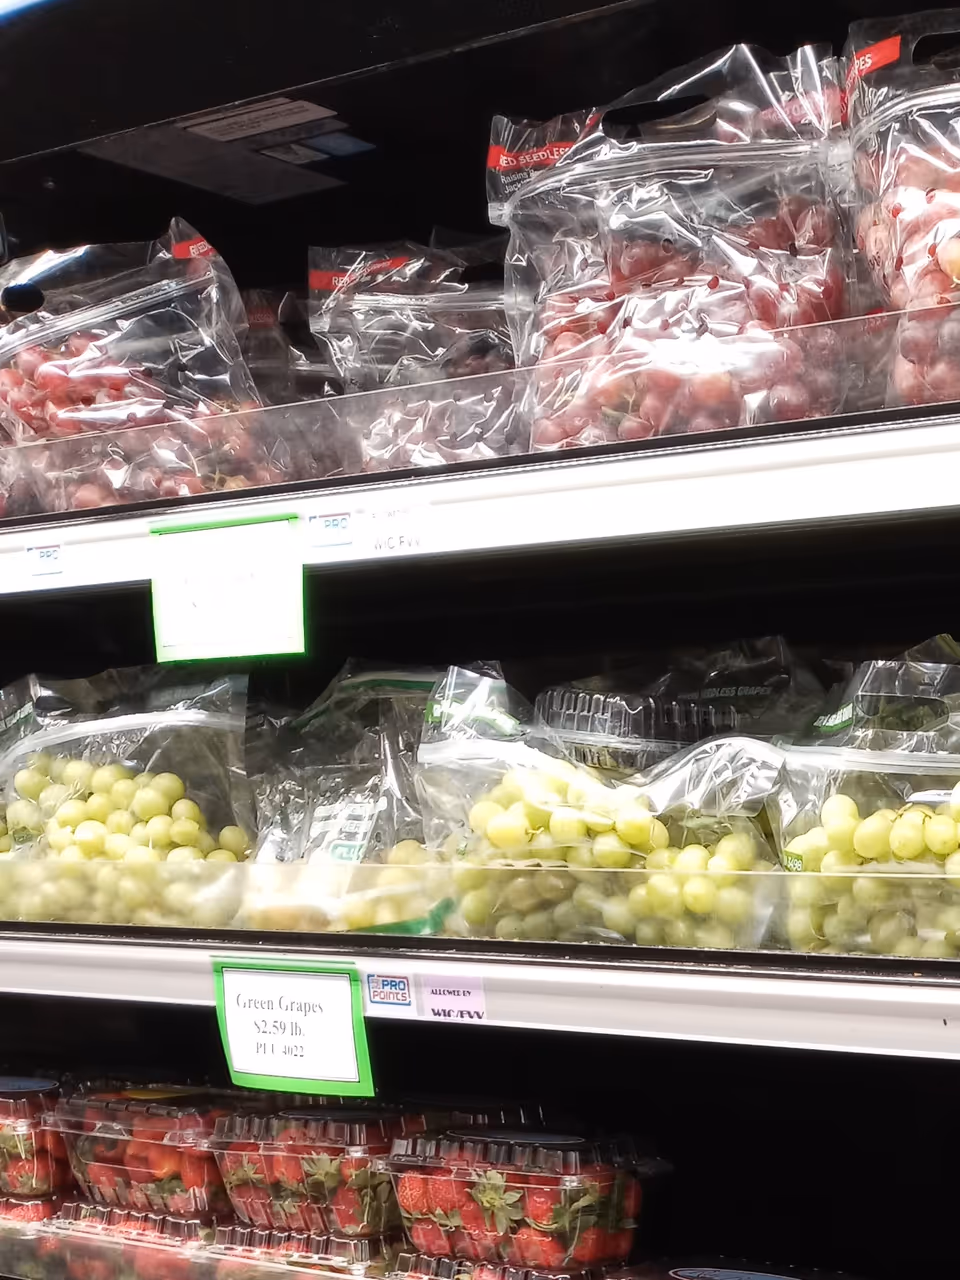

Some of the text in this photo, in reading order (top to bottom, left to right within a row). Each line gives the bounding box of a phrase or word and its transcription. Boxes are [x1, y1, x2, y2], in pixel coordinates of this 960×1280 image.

[381, 980, 406, 992] PRO
[236, 993, 324, 1017] Green Grapes
[253, 1020, 305, 1037] $2.59 lb.
